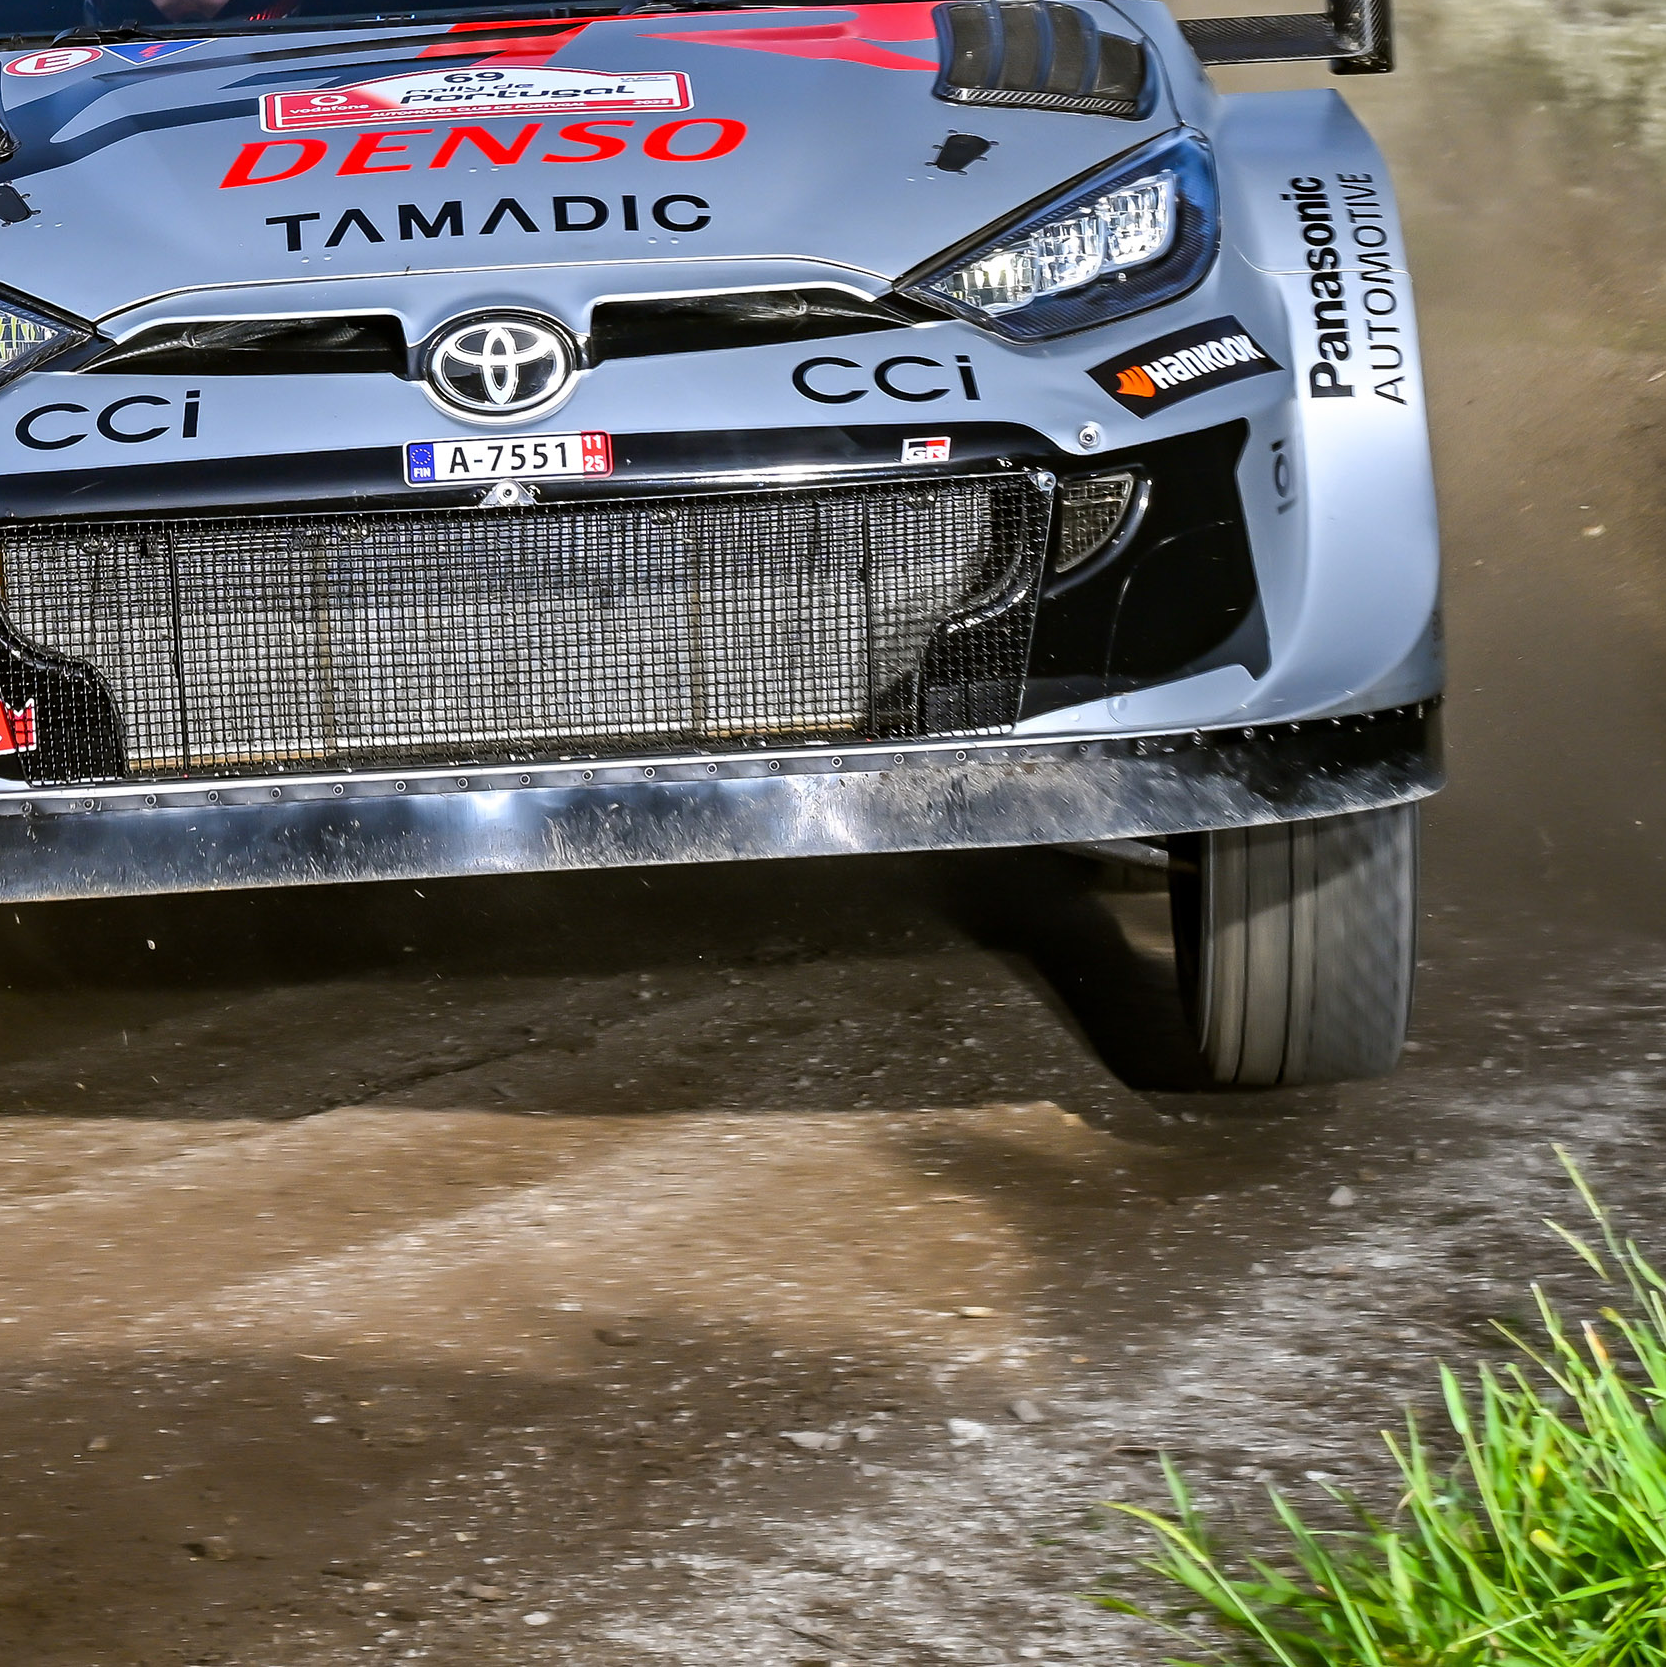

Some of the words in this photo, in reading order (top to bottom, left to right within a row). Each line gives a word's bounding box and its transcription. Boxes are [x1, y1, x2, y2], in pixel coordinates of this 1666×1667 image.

[35, 52, 72, 70] E
[444, 72, 505, 83] 69
[289, 104, 369, 114] vodafone
[515, 102, 588, 110] PORTUGAL
[218, 118, 748, 189] DENSO
[265, 194, 712, 253] TAMADIC
[1280, 176, 1356, 399] Panasonic
[1336, 172, 1408, 406] AUTOMOTIVE
[583, 434, 602, 450] 11
[449, 442, 568, 474] A-7551
[584, 455, 605, 472] 25
[413, 466, 432, 478] FIN
